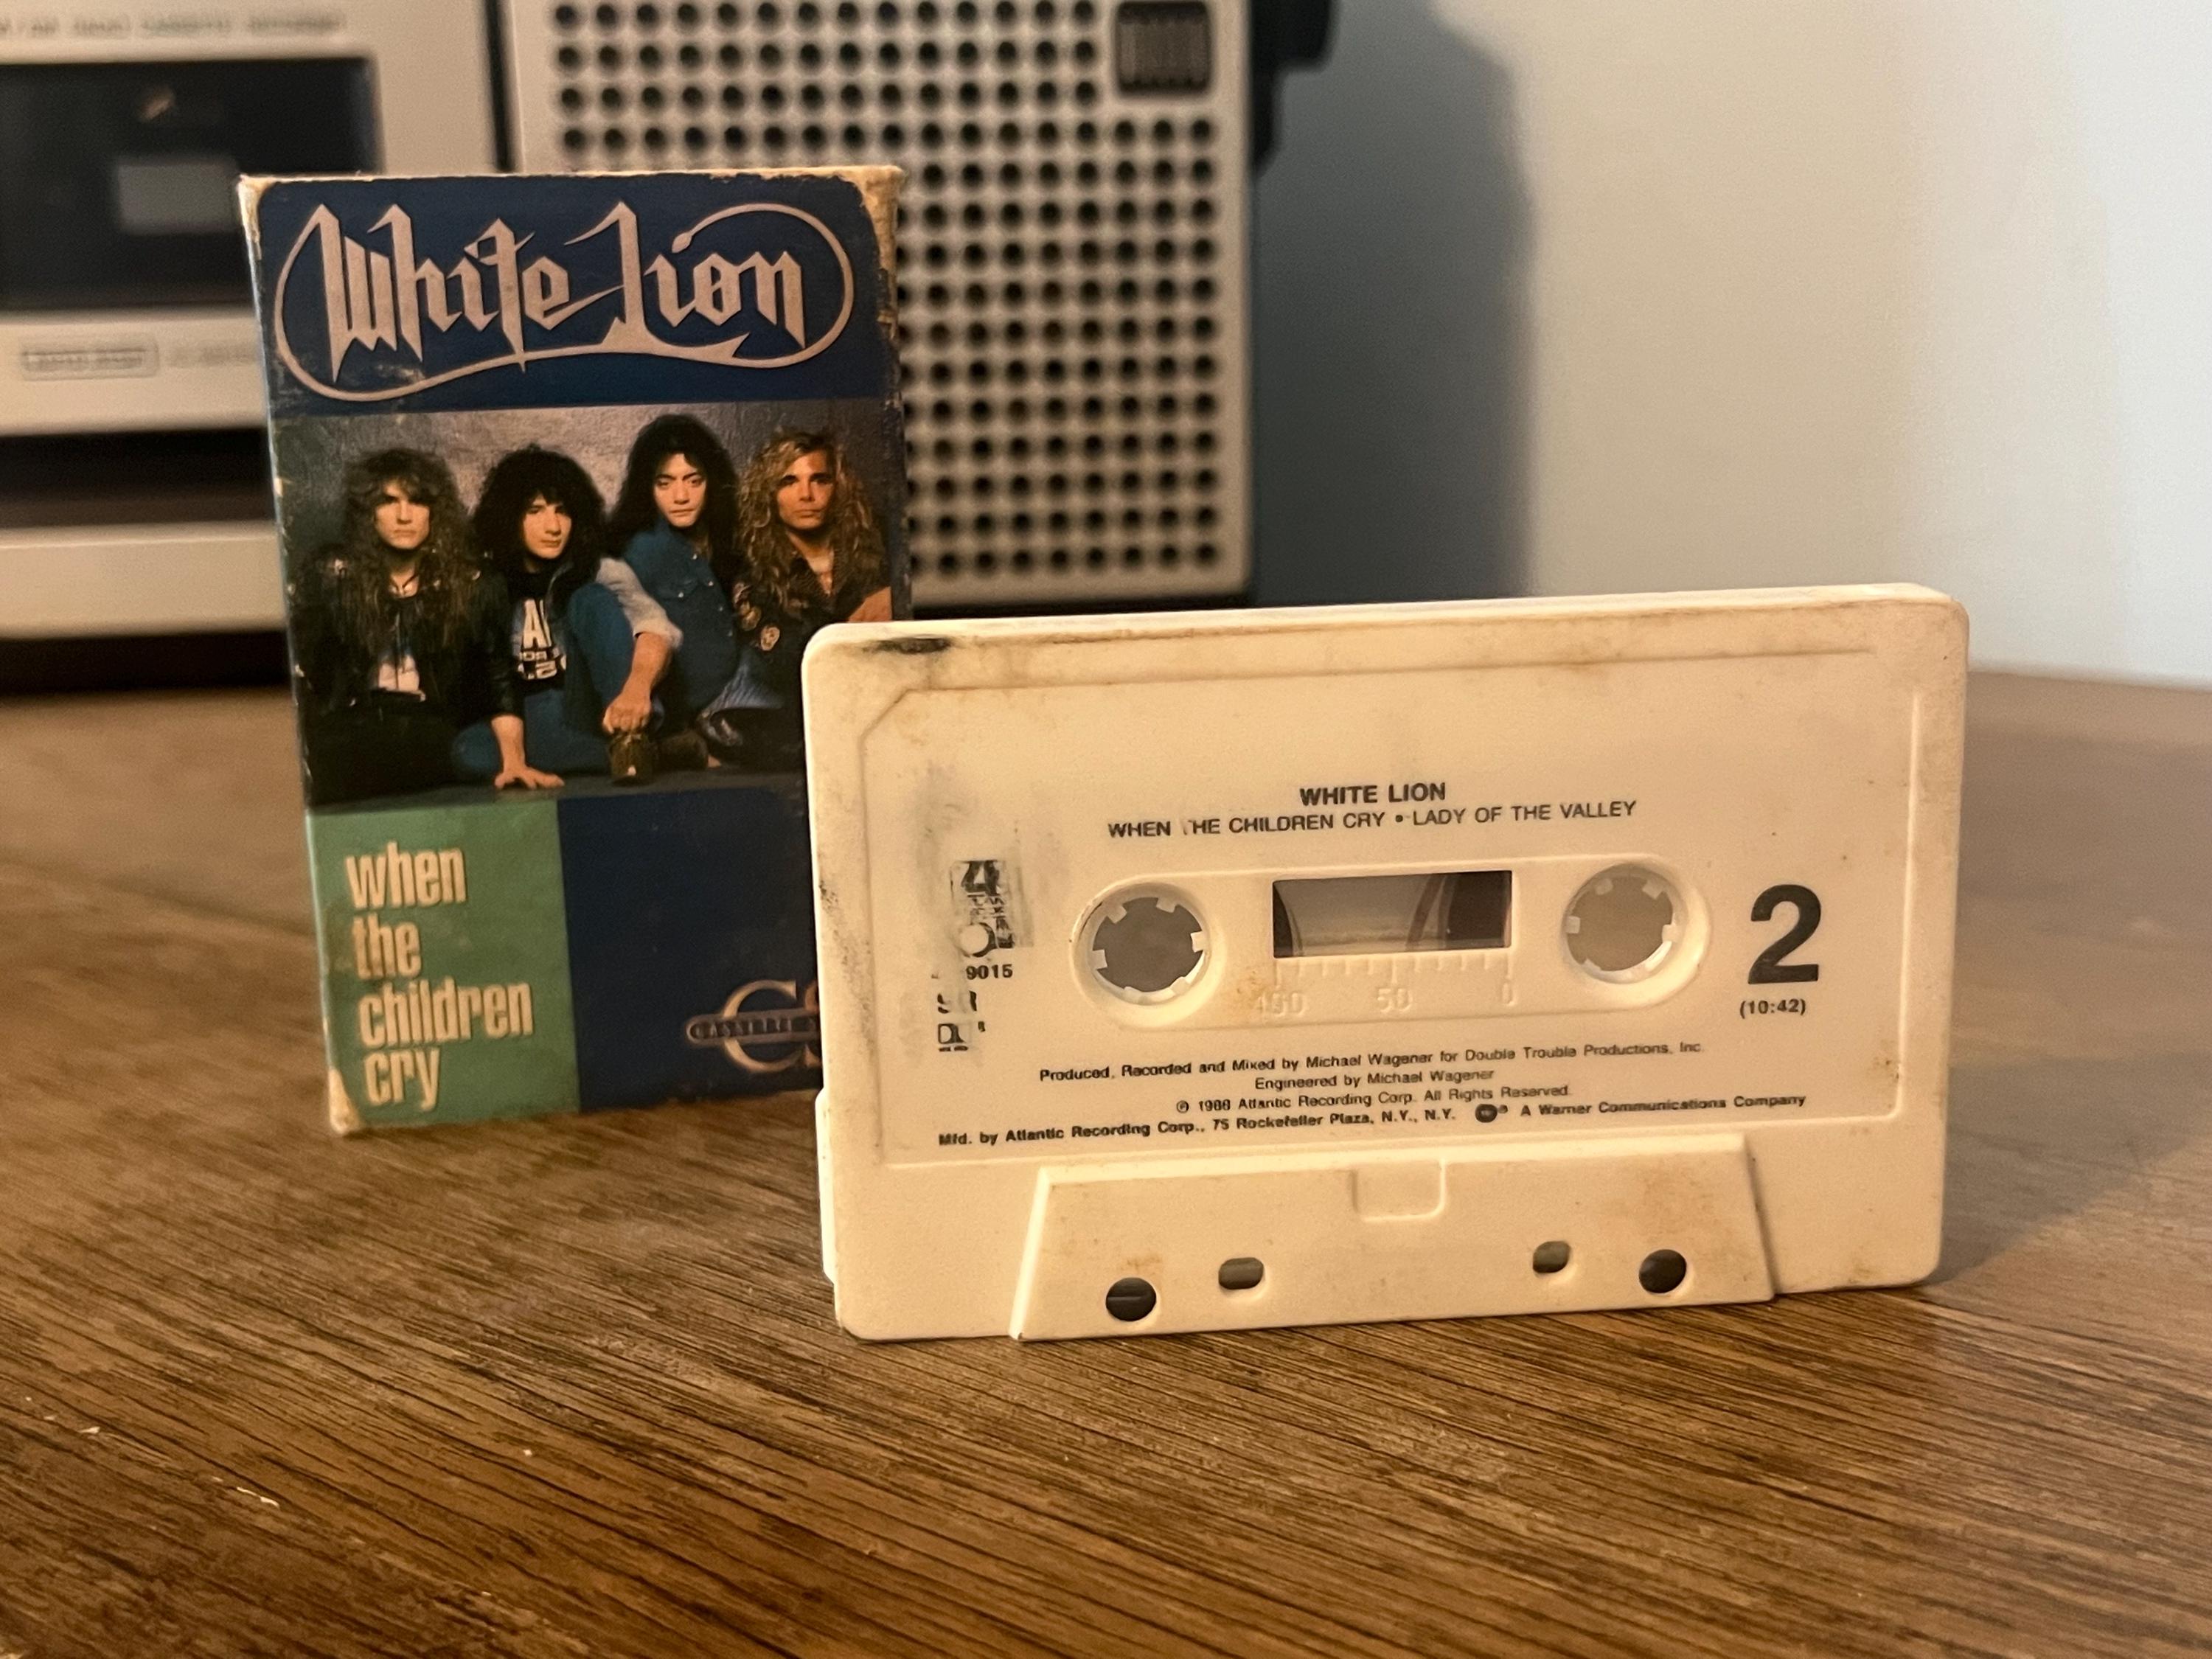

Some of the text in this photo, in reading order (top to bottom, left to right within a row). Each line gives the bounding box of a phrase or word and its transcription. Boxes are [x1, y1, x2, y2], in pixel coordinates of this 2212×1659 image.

[274, 201, 855, 401] White Lion
[1108, 821, 1171, 838] WHEN
[1228, 814, 1335, 833] CHILDREN
[1343, 811, 1385, 829] CRY
[1413, 808, 1467, 826] LADY
[1475, 807, 1502, 824] OF
[1510, 804, 1551, 821] THE
[1559, 800, 1637, 818] VALLEY
[1300, 782, 1446, 806] WHITE LION
[346, 841, 467, 909] when
[352, 913, 422, 981] the
[1748, 884, 1821, 984] 2
[358, 977, 533, 1049] children
[1739, 998, 1806, 1020] (10:42)
[364, 1046, 441, 1110] cry
[1121, 1062, 1192, 1078] Recorded
[1198, 1060, 1226, 1074] and
[1232, 1058, 1276, 1073] Mixed
[1281, 1057, 1300, 1072] by
[1306, 1054, 1362, 1069] Michael
[1440, 1050, 1458, 1062] for
[1465, 1048, 1516, 1062] Double
[1523, 1045, 1577, 1059] Trouble
[1255, 1076, 1338, 1093] Engineered
[1343, 1075, 1361, 1089] by
[1367, 1071, 1423, 1085] Michael
[979, 1131, 998, 1147] by
[1005, 1128, 1064, 1142] Atlantic
[1071, 1123, 1150, 1139] Recording
[1212, 1119, 1229, 1131] 75
[1520, 1104, 1531, 1117] A
[1598, 1099, 1727, 1113] Communications
[1733, 1095, 1806, 1109] Company
[1238, 1096, 1292, 1110] Atlantic
[1298, 1093, 1372, 1108] Recording
[1424, 1089, 1441, 1102] All
[1448, 1087, 1494, 1103] Rights
